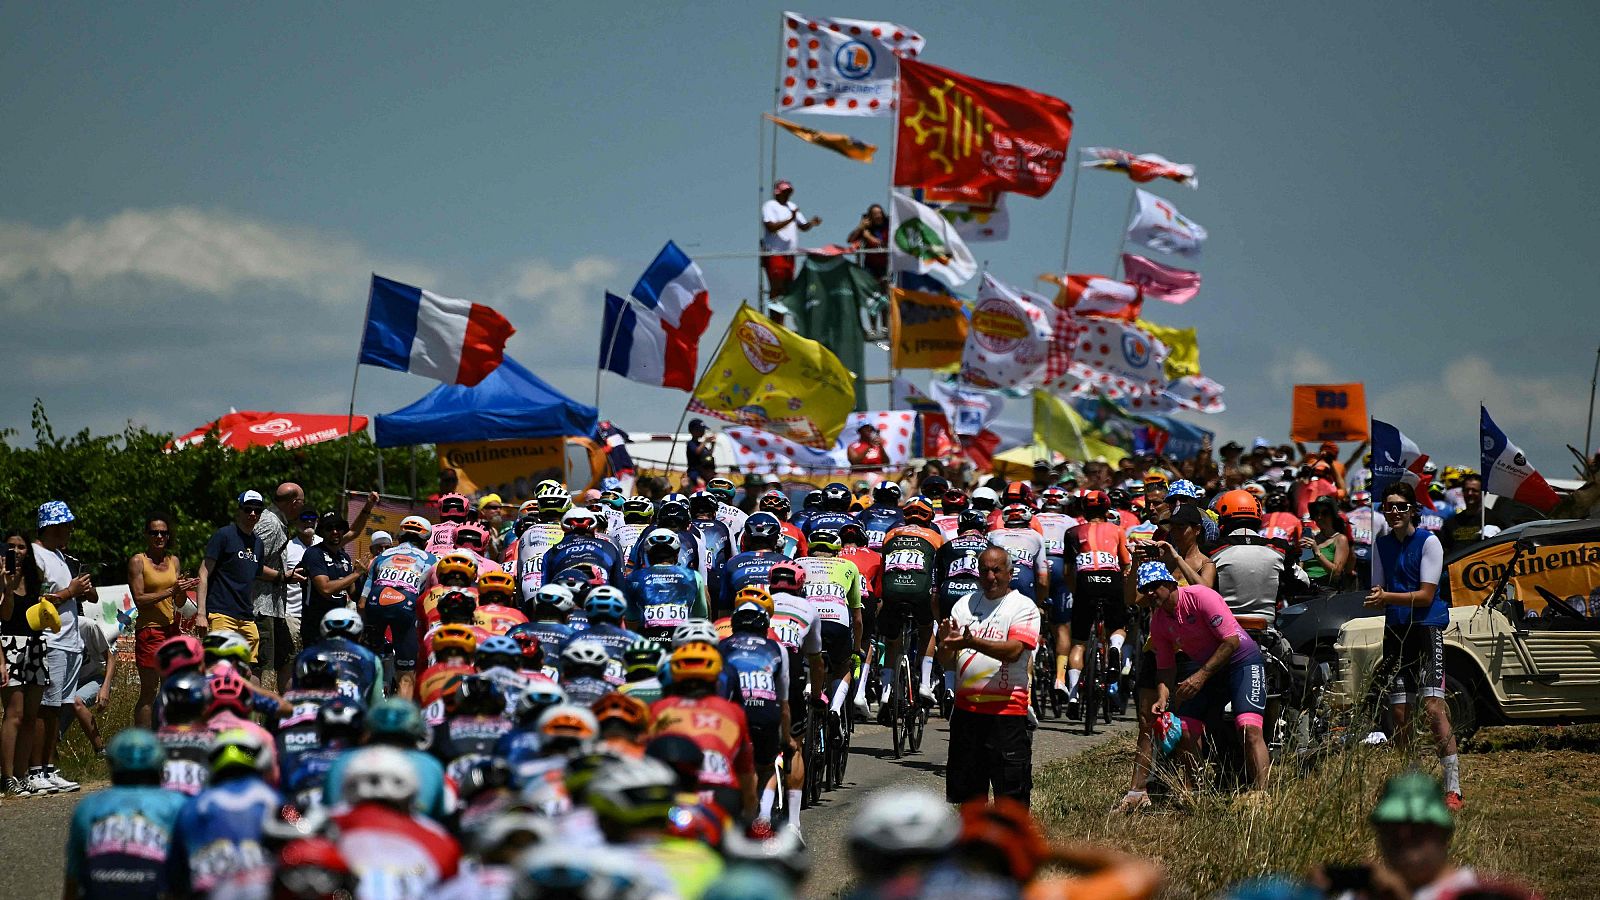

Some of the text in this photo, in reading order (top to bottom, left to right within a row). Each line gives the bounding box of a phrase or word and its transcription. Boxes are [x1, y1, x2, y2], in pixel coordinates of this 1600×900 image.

[994, 132, 1013, 149] La
[1374, 463, 1383, 472] La
[1496, 459, 1506, 467] La
[565, 544, 585, 554] FDJ
[890, 552, 919, 564] 27 27
[951, 556, 978, 572] 84 8
[1078, 552, 1114, 565] 35 35
[744, 565, 766, 575] FDJ
[399, 571, 420, 589] 186
[1087, 575, 1112, 583] INEOS
[826, 584, 846, 599] 178
[948, 581, 978, 590] BORA
[647, 606, 687, 620] 56 56
[284, 732, 318, 745] BOR
